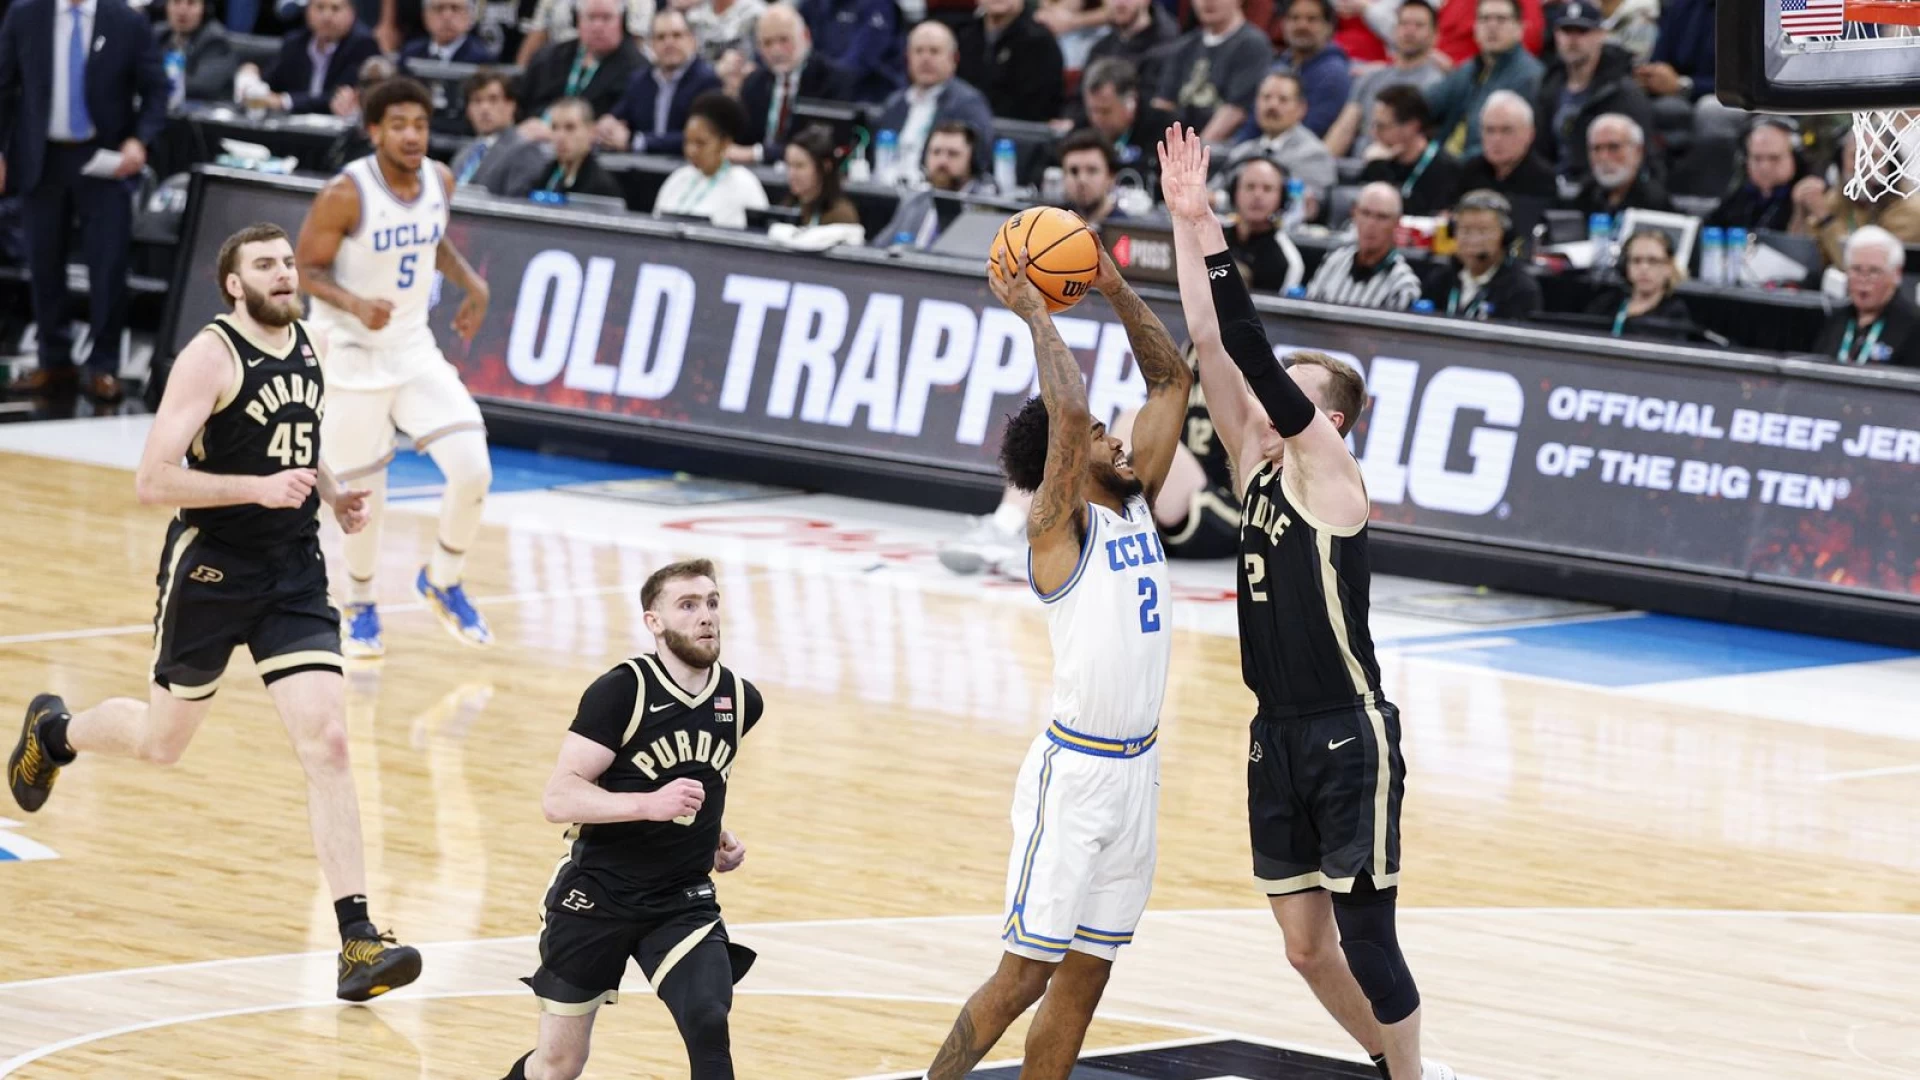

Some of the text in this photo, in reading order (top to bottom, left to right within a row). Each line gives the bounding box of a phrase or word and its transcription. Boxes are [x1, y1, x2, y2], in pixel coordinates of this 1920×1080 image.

[397, 253, 417, 289] 5
[507, 249, 696, 400] OLD
[267, 422, 313, 466] 45
[1548, 386, 1920, 464] OFFICIAL BEEF JER
[1535, 442, 1595, 478] OF
[1598, 449, 1676, 490] THE
[1678, 459, 1752, 499] BIG
[1138, 576, 1160, 633] 2
[1244, 553, 1268, 601] 2
